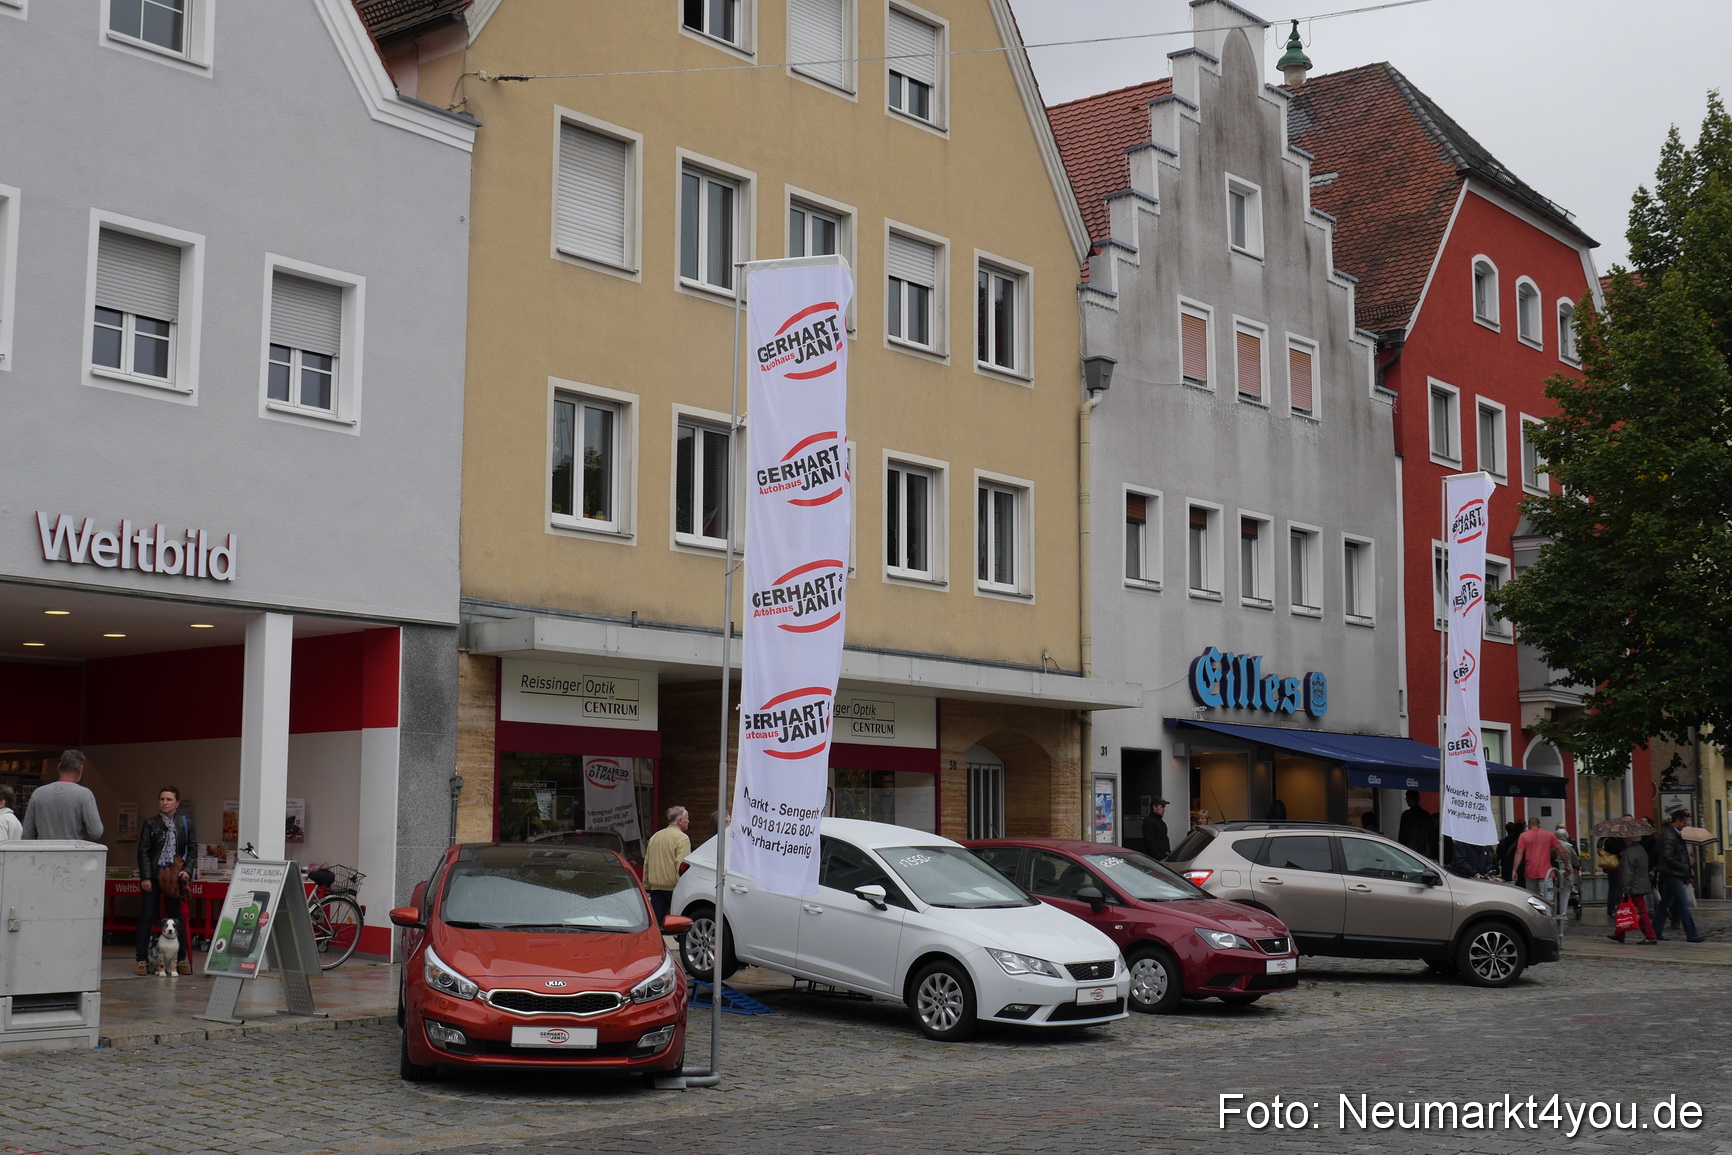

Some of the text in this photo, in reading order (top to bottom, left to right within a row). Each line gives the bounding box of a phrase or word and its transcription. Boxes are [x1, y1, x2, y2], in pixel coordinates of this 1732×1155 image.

[757, 314, 836, 363] GERHART
[757, 445, 839, 486] GERHART
[801, 461, 841, 491] JÄNI
[760, 479, 802, 495] Autohaus
[35, 511, 237, 581] Weltbild
[752, 572, 836, 608] GERHART
[520, 674, 615, 695] Reissinger Optik
[1189, 646, 1301, 714] Eilles
[584, 701, 637, 716] CENTRUM
[853, 703, 876, 717] Optik
[853, 722, 894, 735] CENTRUM
[1100, 746, 1108, 757] 31
[751, 815, 797, 836] 09181/26
[240, 867, 256, 875] TABLET
[115, 883, 141, 893] Weltbi
